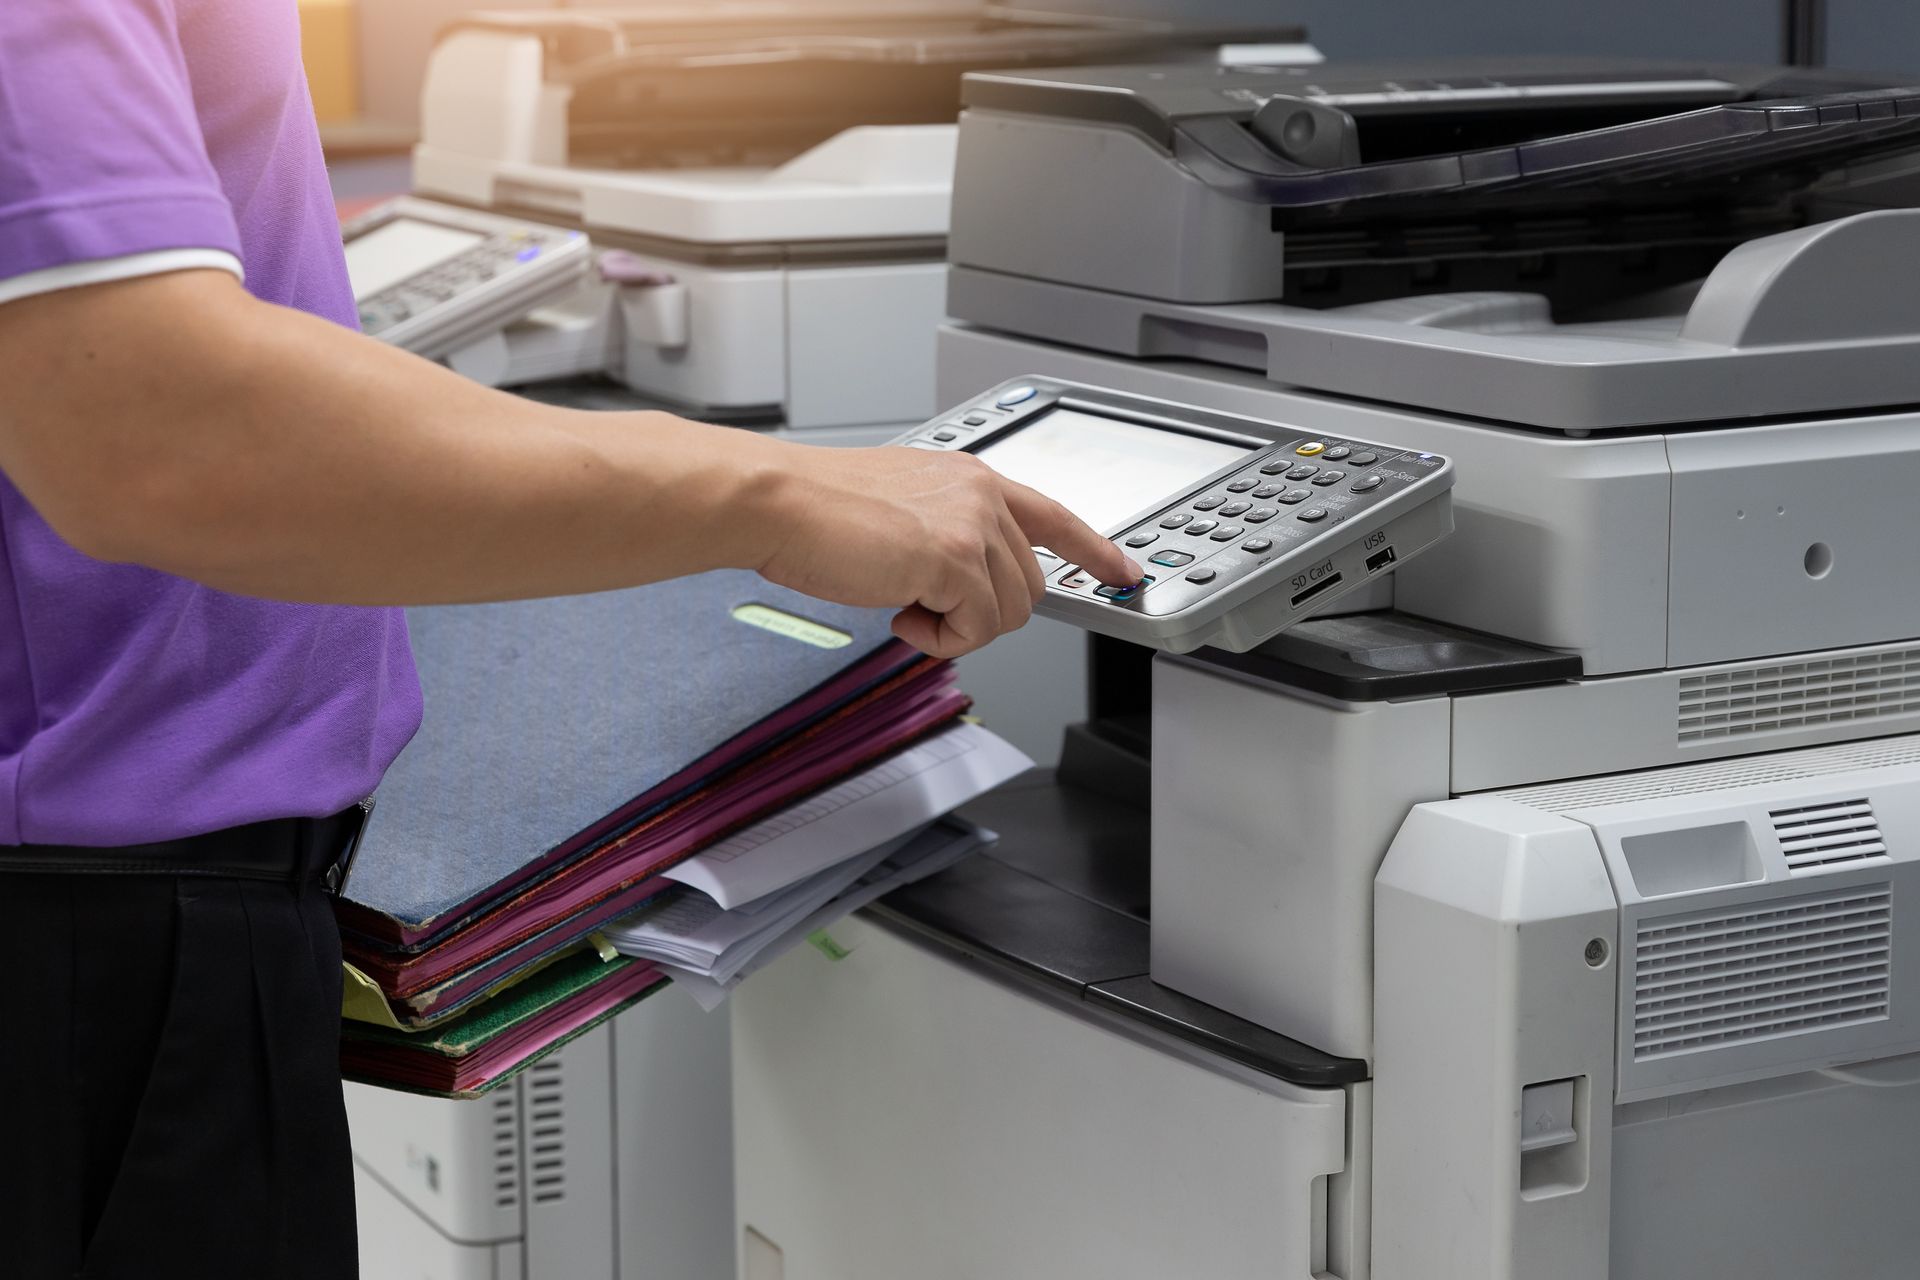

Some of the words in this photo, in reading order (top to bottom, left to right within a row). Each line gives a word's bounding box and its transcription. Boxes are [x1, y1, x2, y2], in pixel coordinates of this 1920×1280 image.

[1363, 532, 1386, 550] USB
[1292, 575, 1308, 591] SD
[1310, 560, 1333, 580] Card
